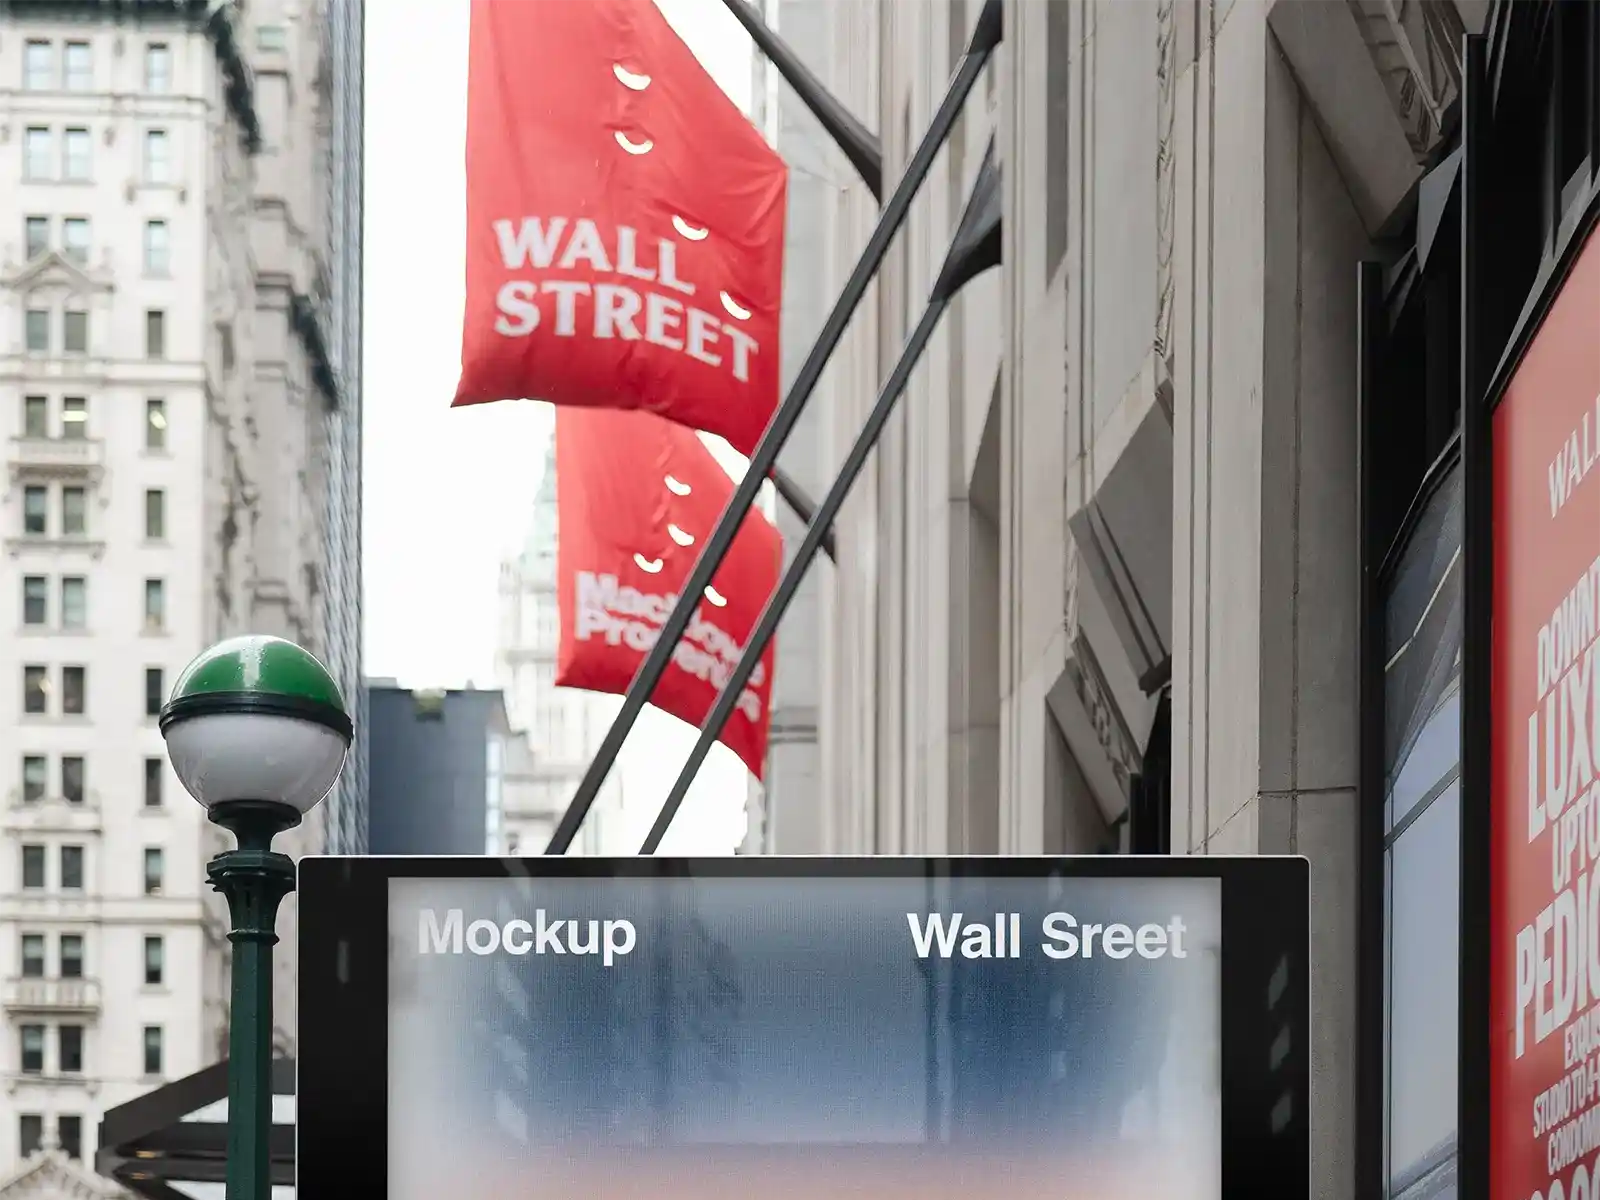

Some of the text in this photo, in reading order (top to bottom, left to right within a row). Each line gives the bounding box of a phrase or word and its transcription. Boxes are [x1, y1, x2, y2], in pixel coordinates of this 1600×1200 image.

[492, 216, 696, 295] WALL
[494, 280, 759, 383] STREET
[418, 909, 636, 967] Mockup
[907, 912, 1187, 959] Wall Sreet
[1534, 1079, 1570, 1139] STUDIO
[1572, 1065, 1586, 1113] TO
